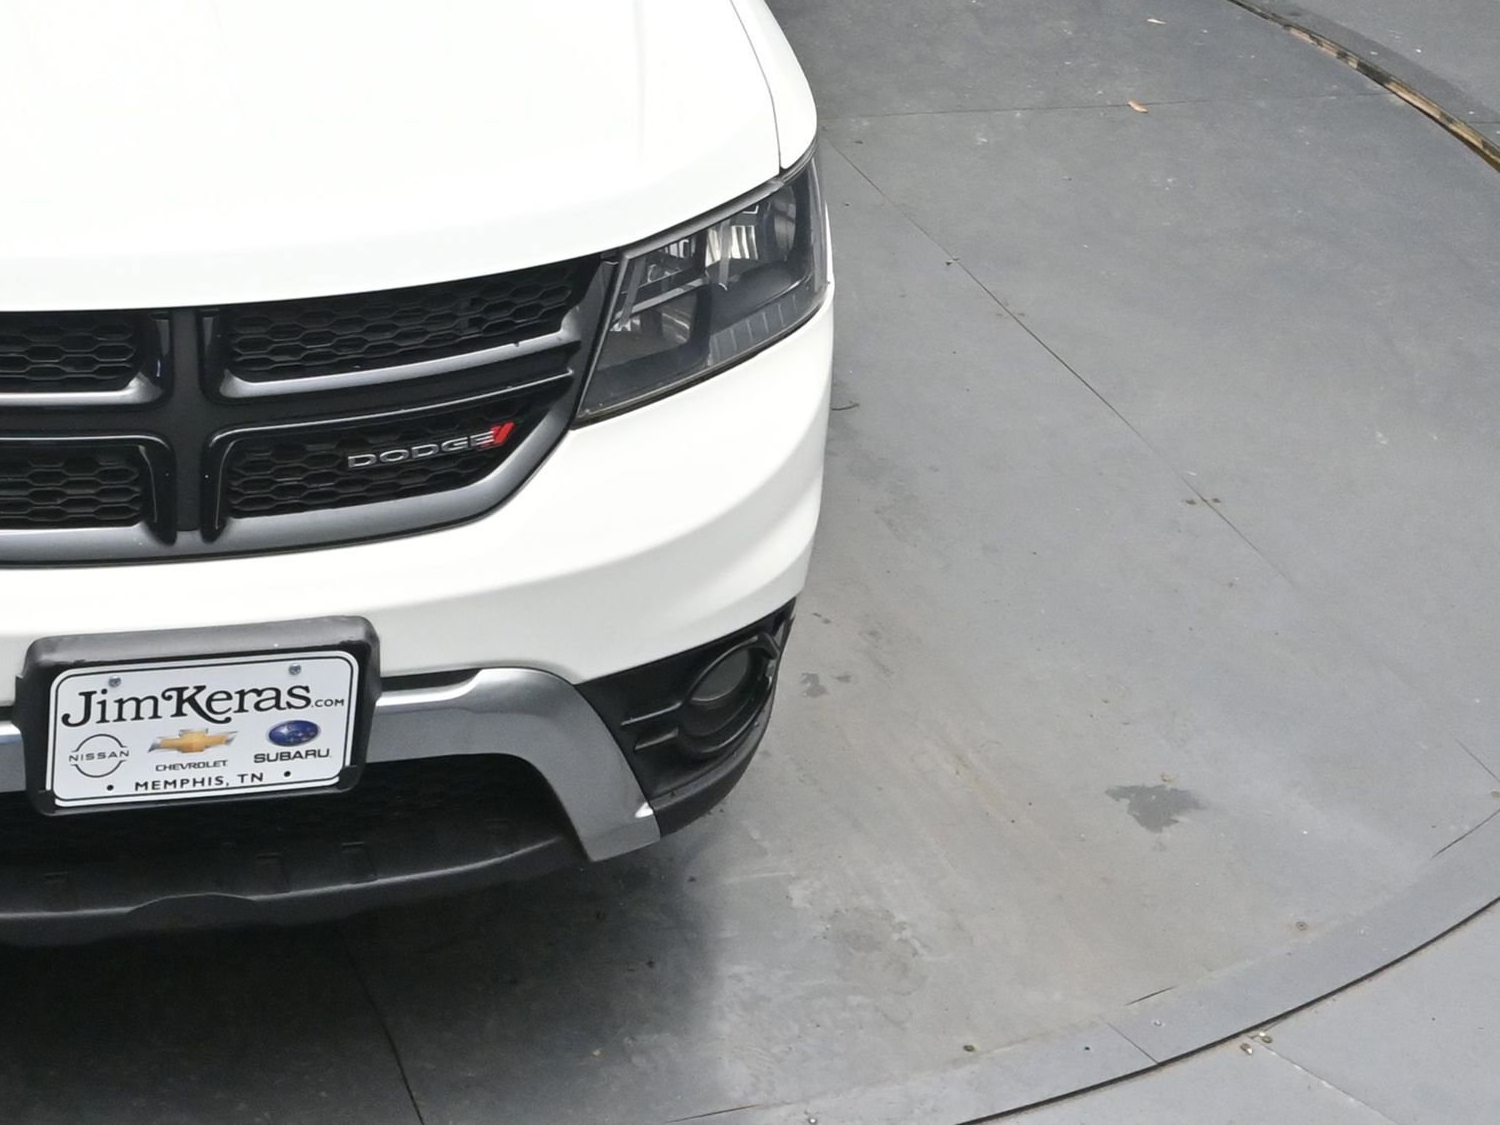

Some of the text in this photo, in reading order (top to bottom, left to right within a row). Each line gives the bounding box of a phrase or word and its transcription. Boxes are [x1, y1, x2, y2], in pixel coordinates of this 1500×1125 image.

[348, 430, 495, 468] DODGE
[68, 747, 130, 762] NISSAN
[253, 748, 331, 764] SUBARU
[155, 759, 228, 772] CHEVROLET
[134, 772, 264, 792] MEMPHIS, TN
